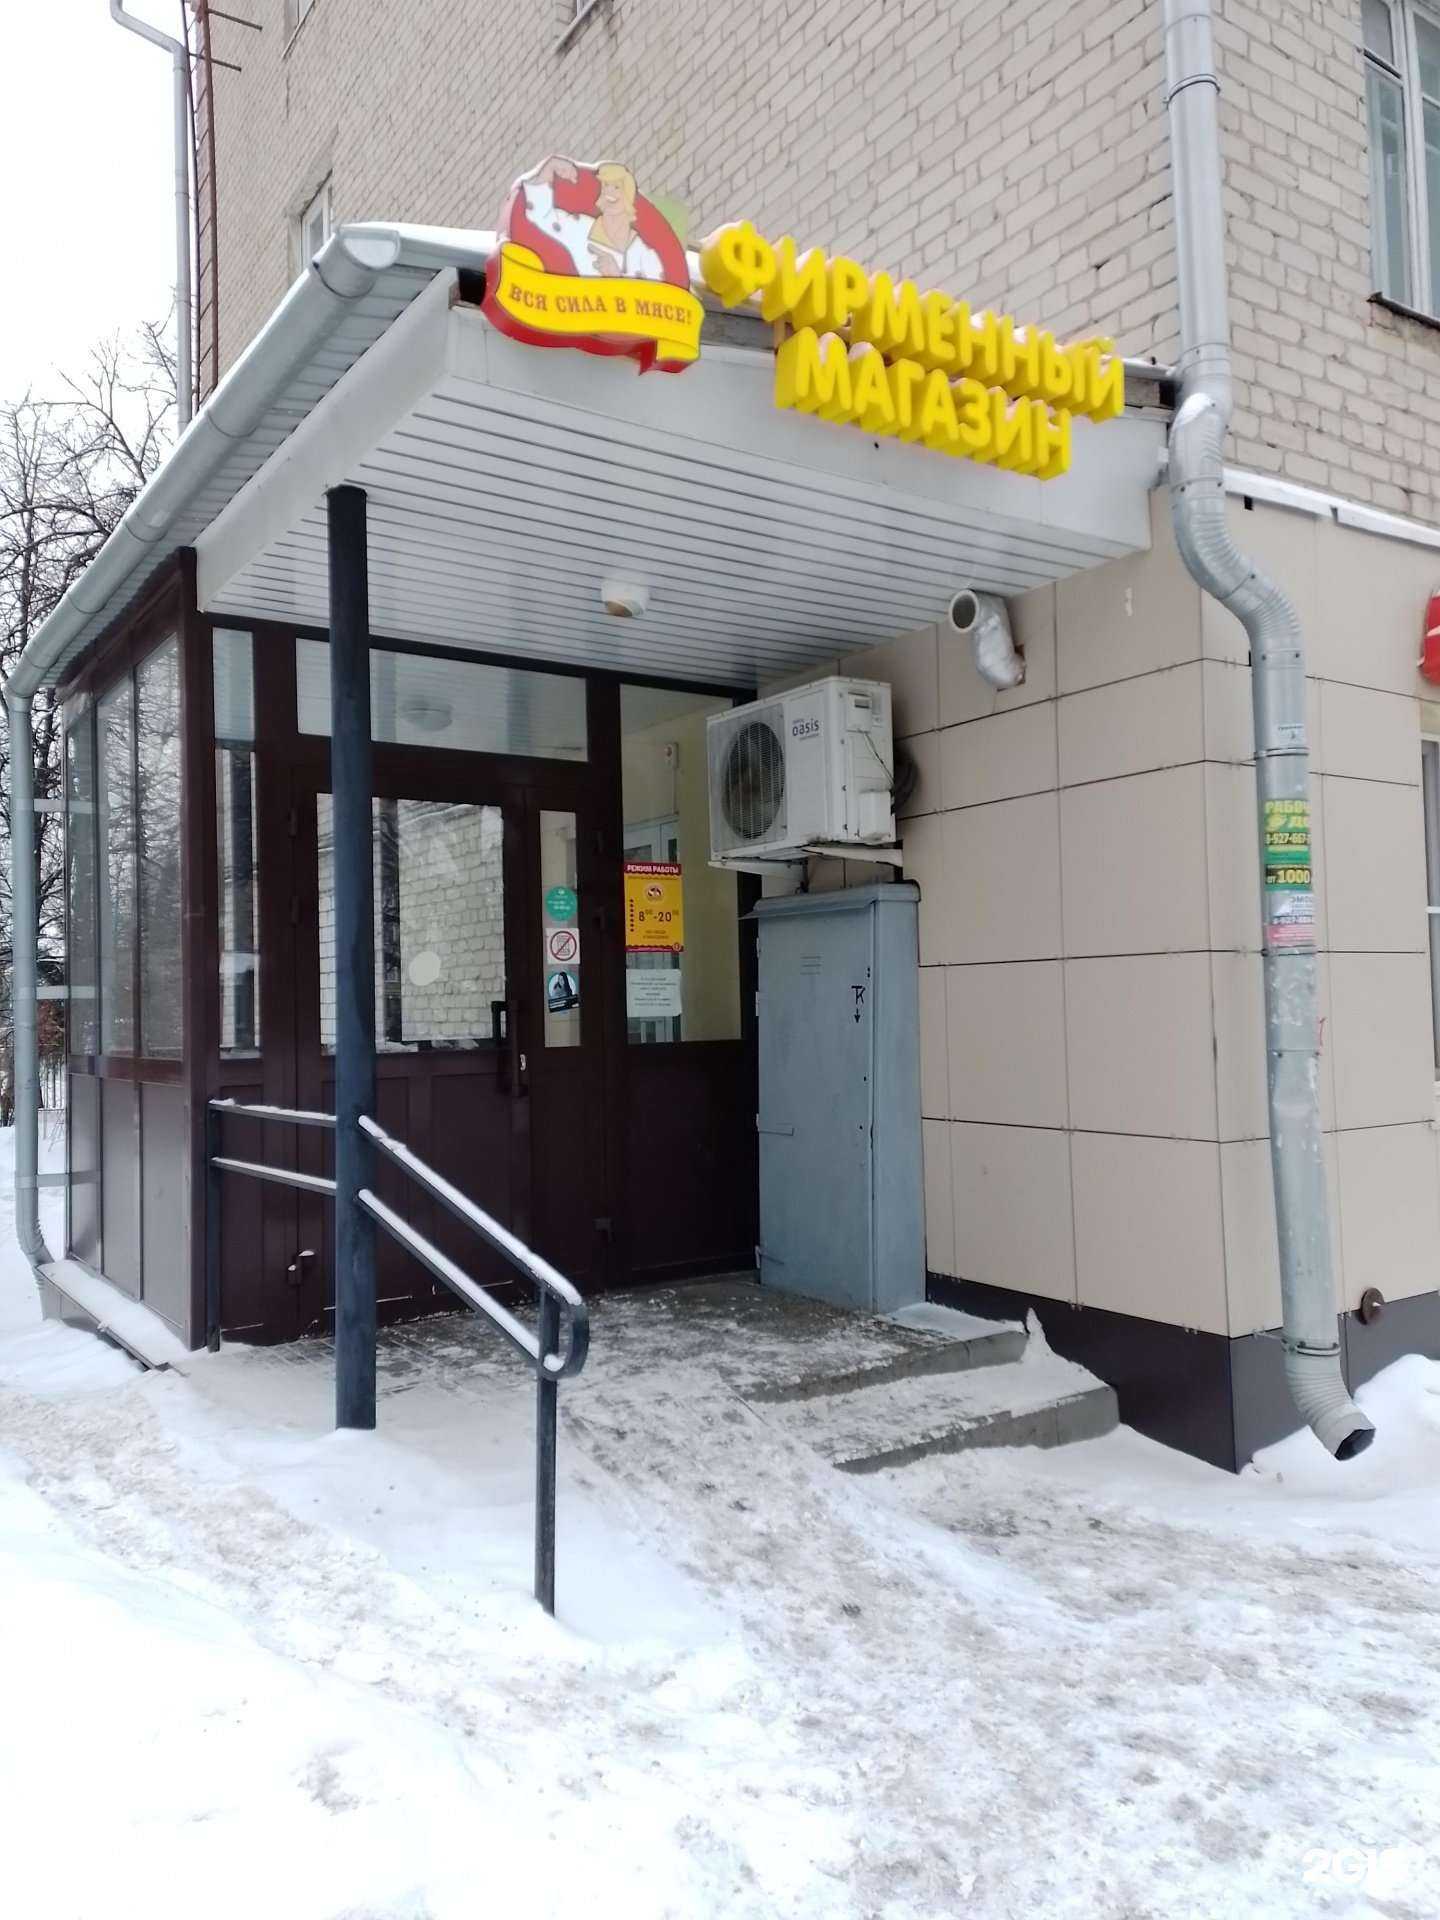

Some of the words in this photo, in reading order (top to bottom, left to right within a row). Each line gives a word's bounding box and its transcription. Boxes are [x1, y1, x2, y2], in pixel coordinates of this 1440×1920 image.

[509, 283, 547, 311] ВСЯ
[556, 295, 607, 313] СИЛА
[615, 296, 626, 313] В
[703, 219, 1124, 422] ФИРМЕННЫЙ
[775, 326, 1071, 480] МАГАЗИН
[792, 719, 819, 736] oasis
